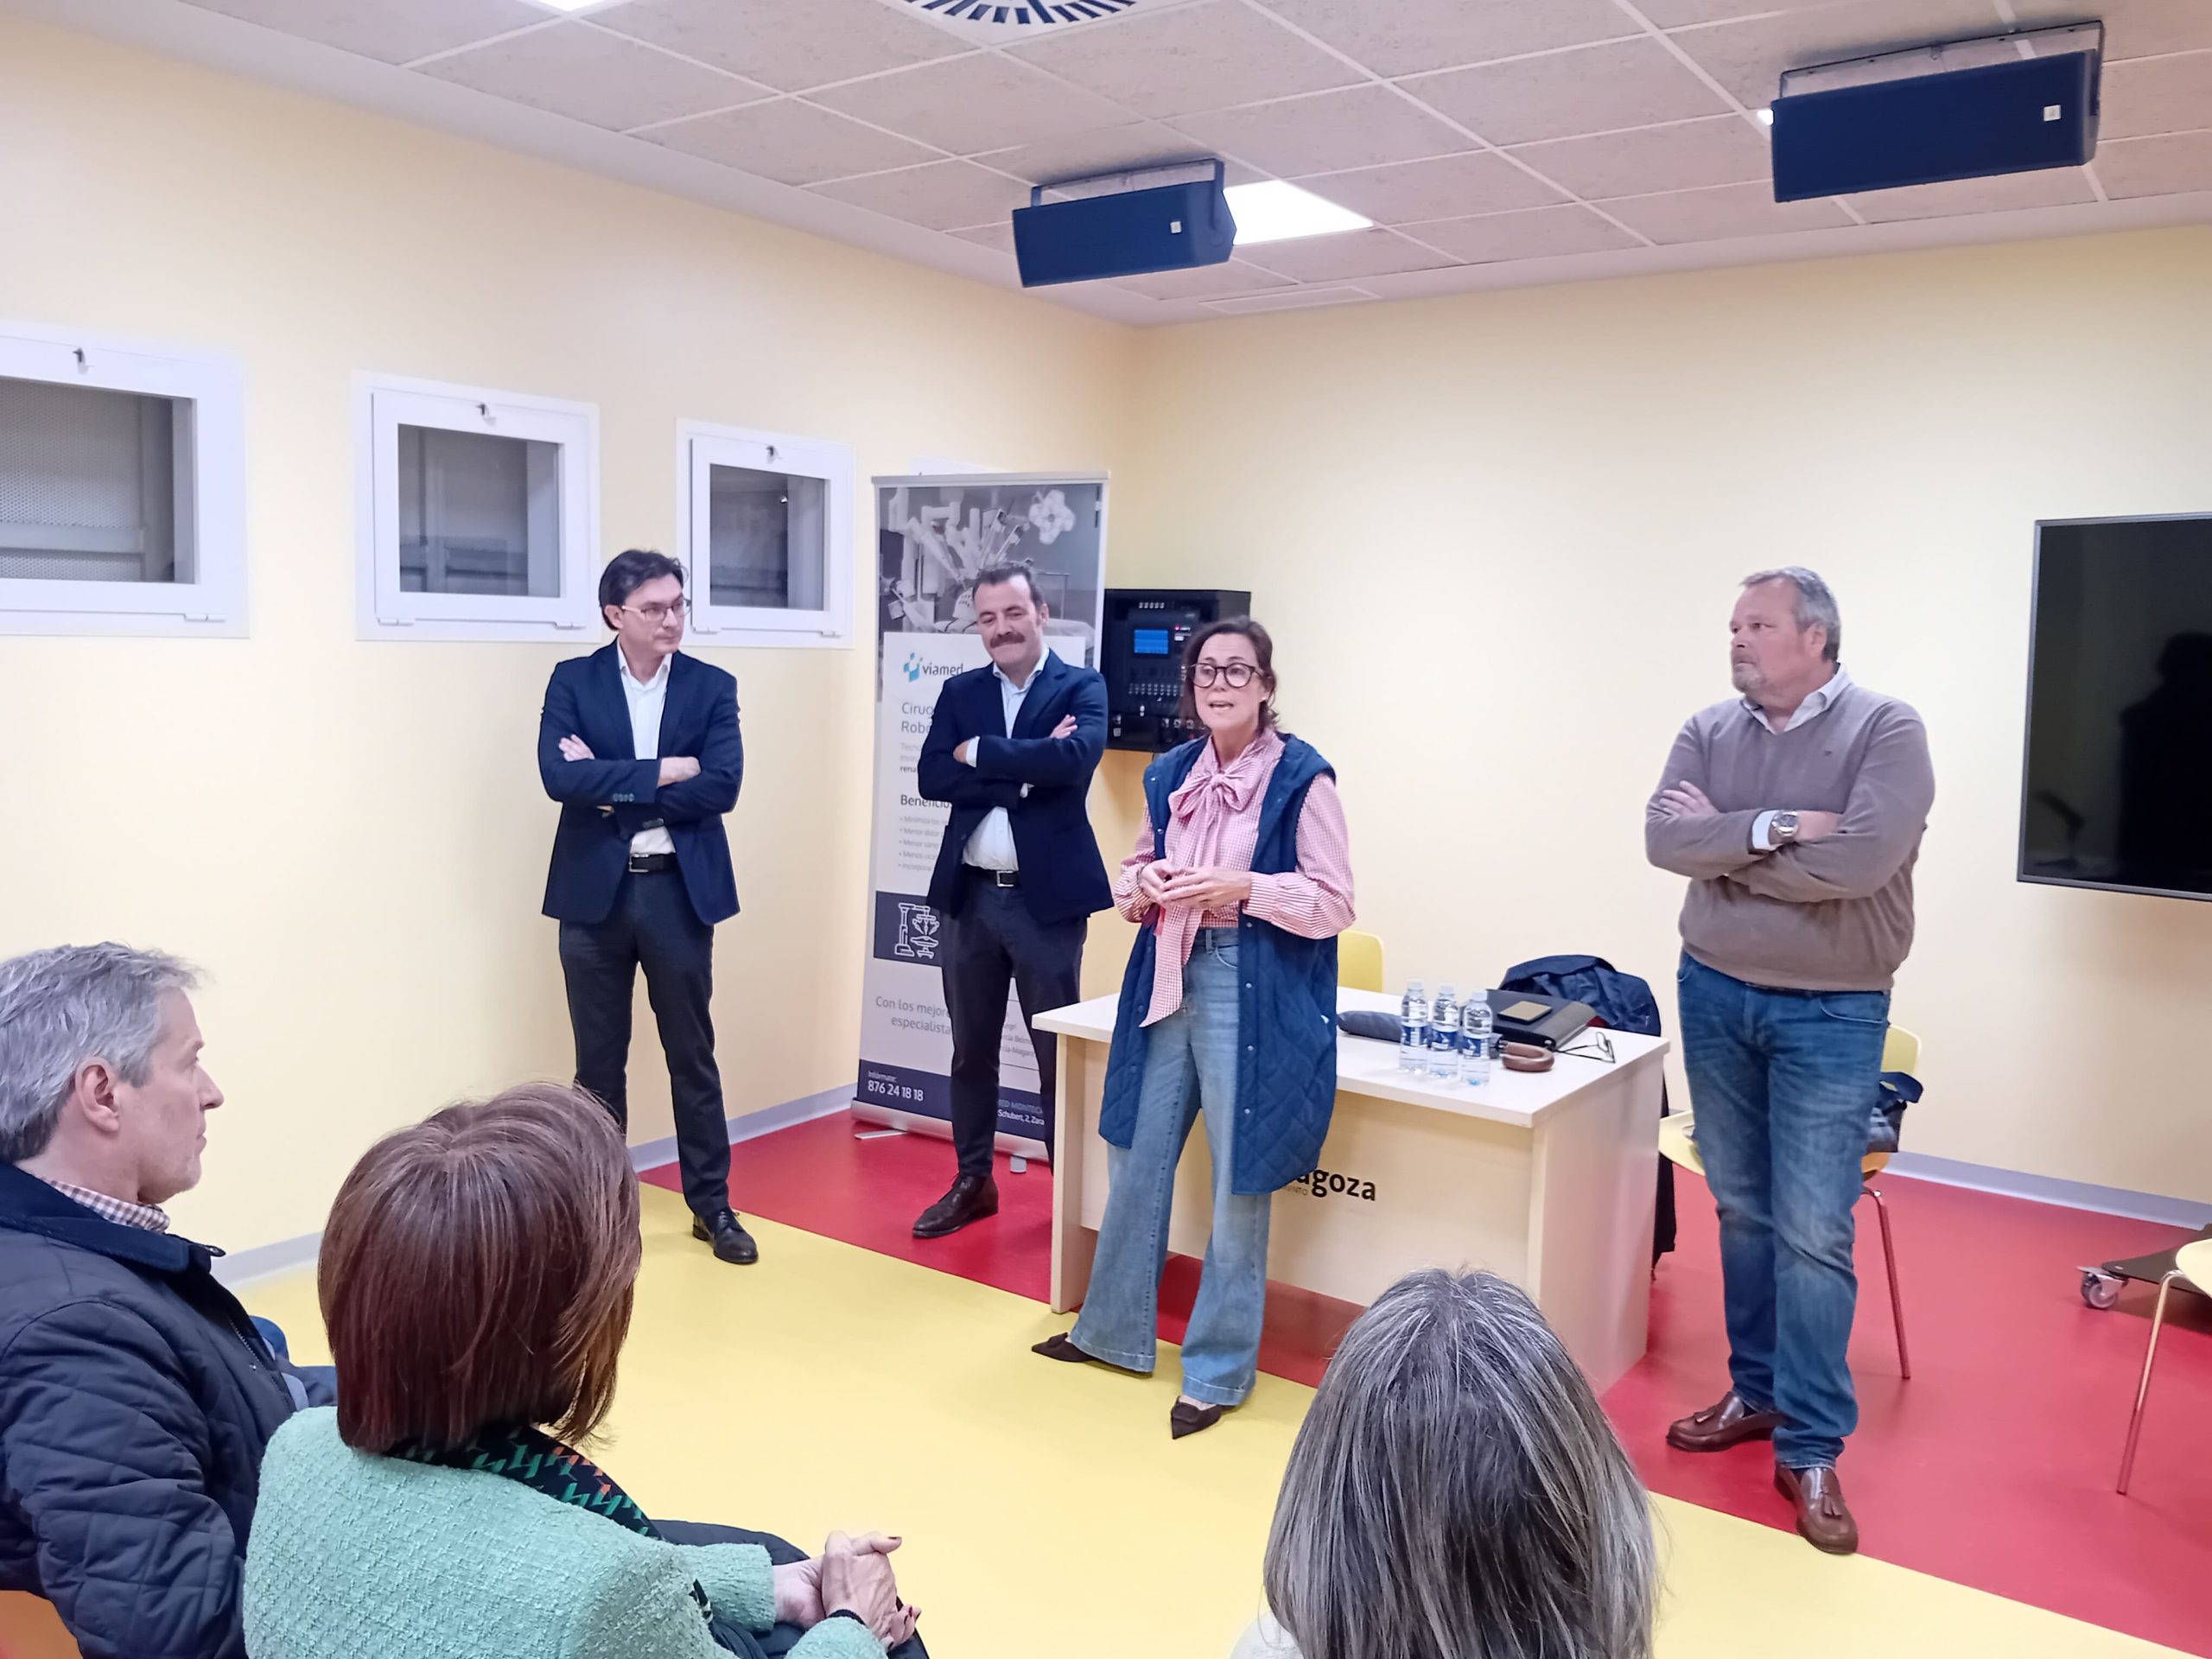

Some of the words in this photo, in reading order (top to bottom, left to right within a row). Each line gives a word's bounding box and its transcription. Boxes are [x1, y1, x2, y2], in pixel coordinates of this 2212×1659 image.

[922, 662, 963, 677] viamed
[875, 995, 895, 1008] Con
[899, 999, 914, 1012] los
[868, 1080, 886, 1094] 876
[887, 1084, 899, 1096] 24
[901, 1086, 912, 1099] 18
[913, 1089, 924, 1102] 18
